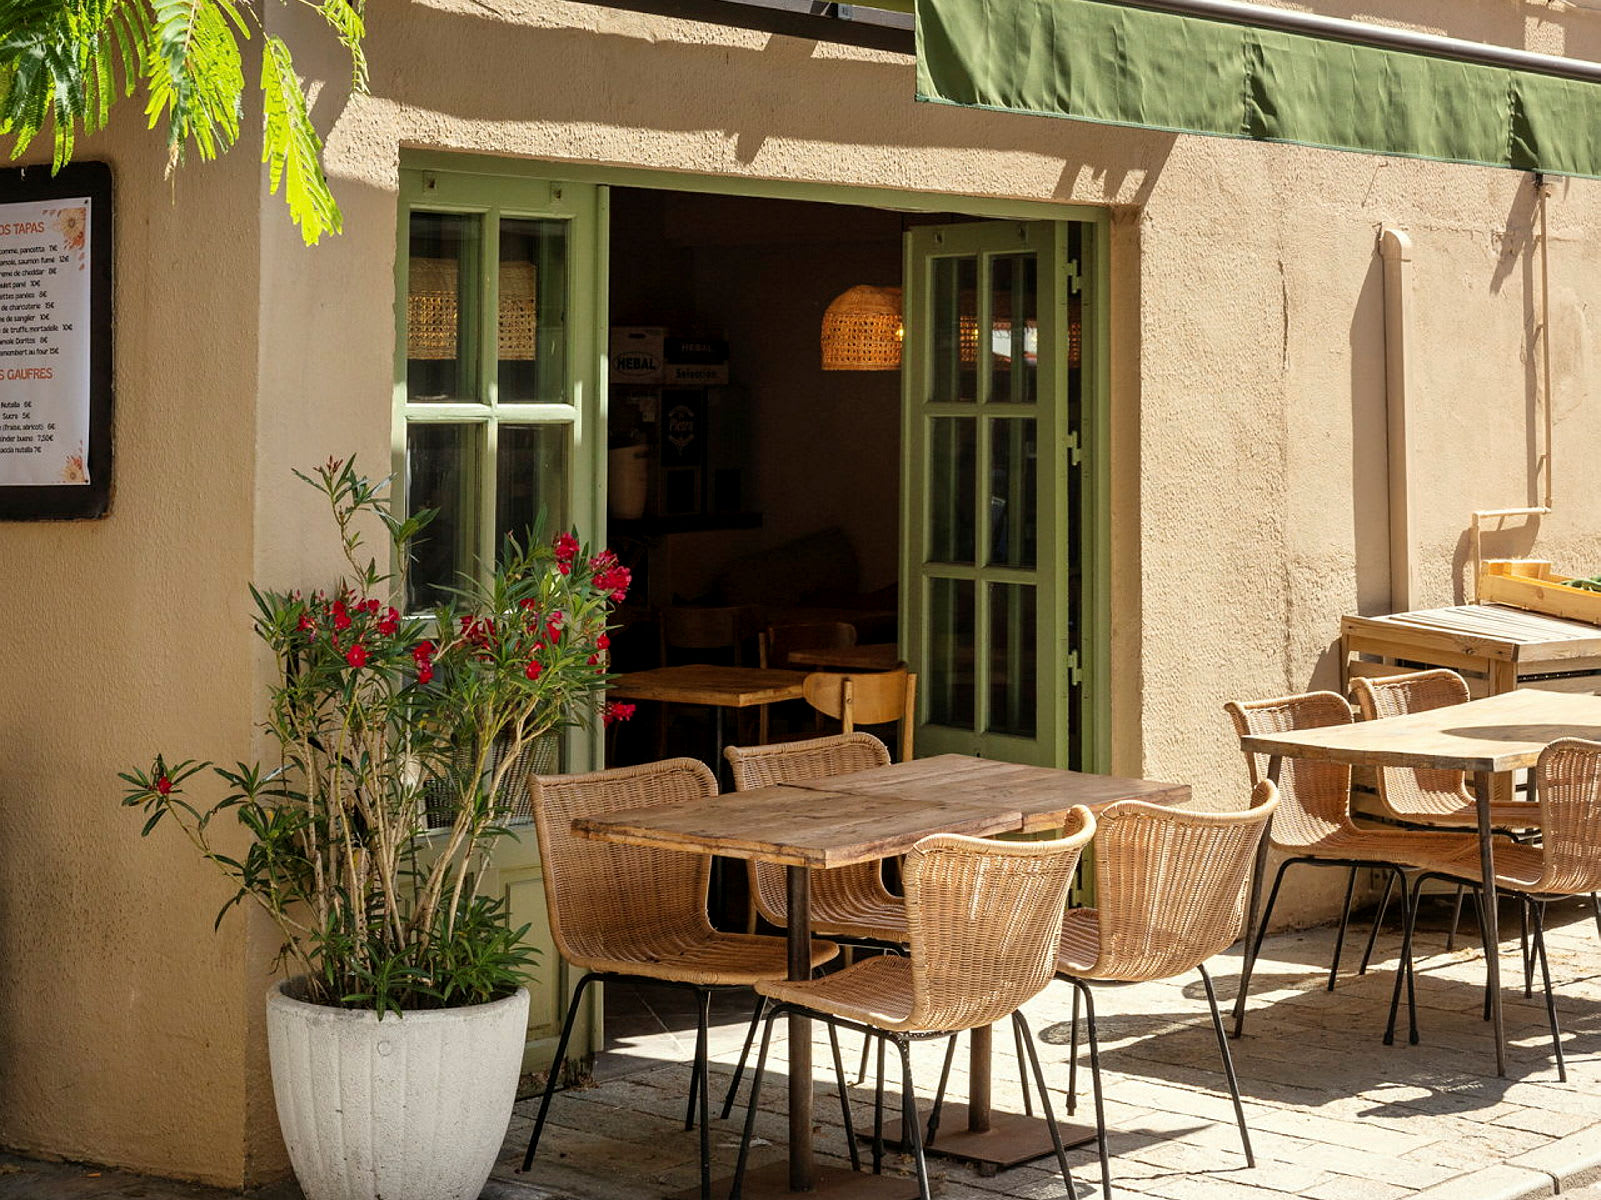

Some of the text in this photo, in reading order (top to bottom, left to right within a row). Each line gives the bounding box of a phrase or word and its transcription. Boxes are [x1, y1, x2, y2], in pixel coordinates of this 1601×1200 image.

[0, 221, 45, 236] OS TAPAS
[616, 357, 656, 371] HEBAL
[7, 367, 53, 380] GAUFRES
[2, 412, 18, 420] Sucre
